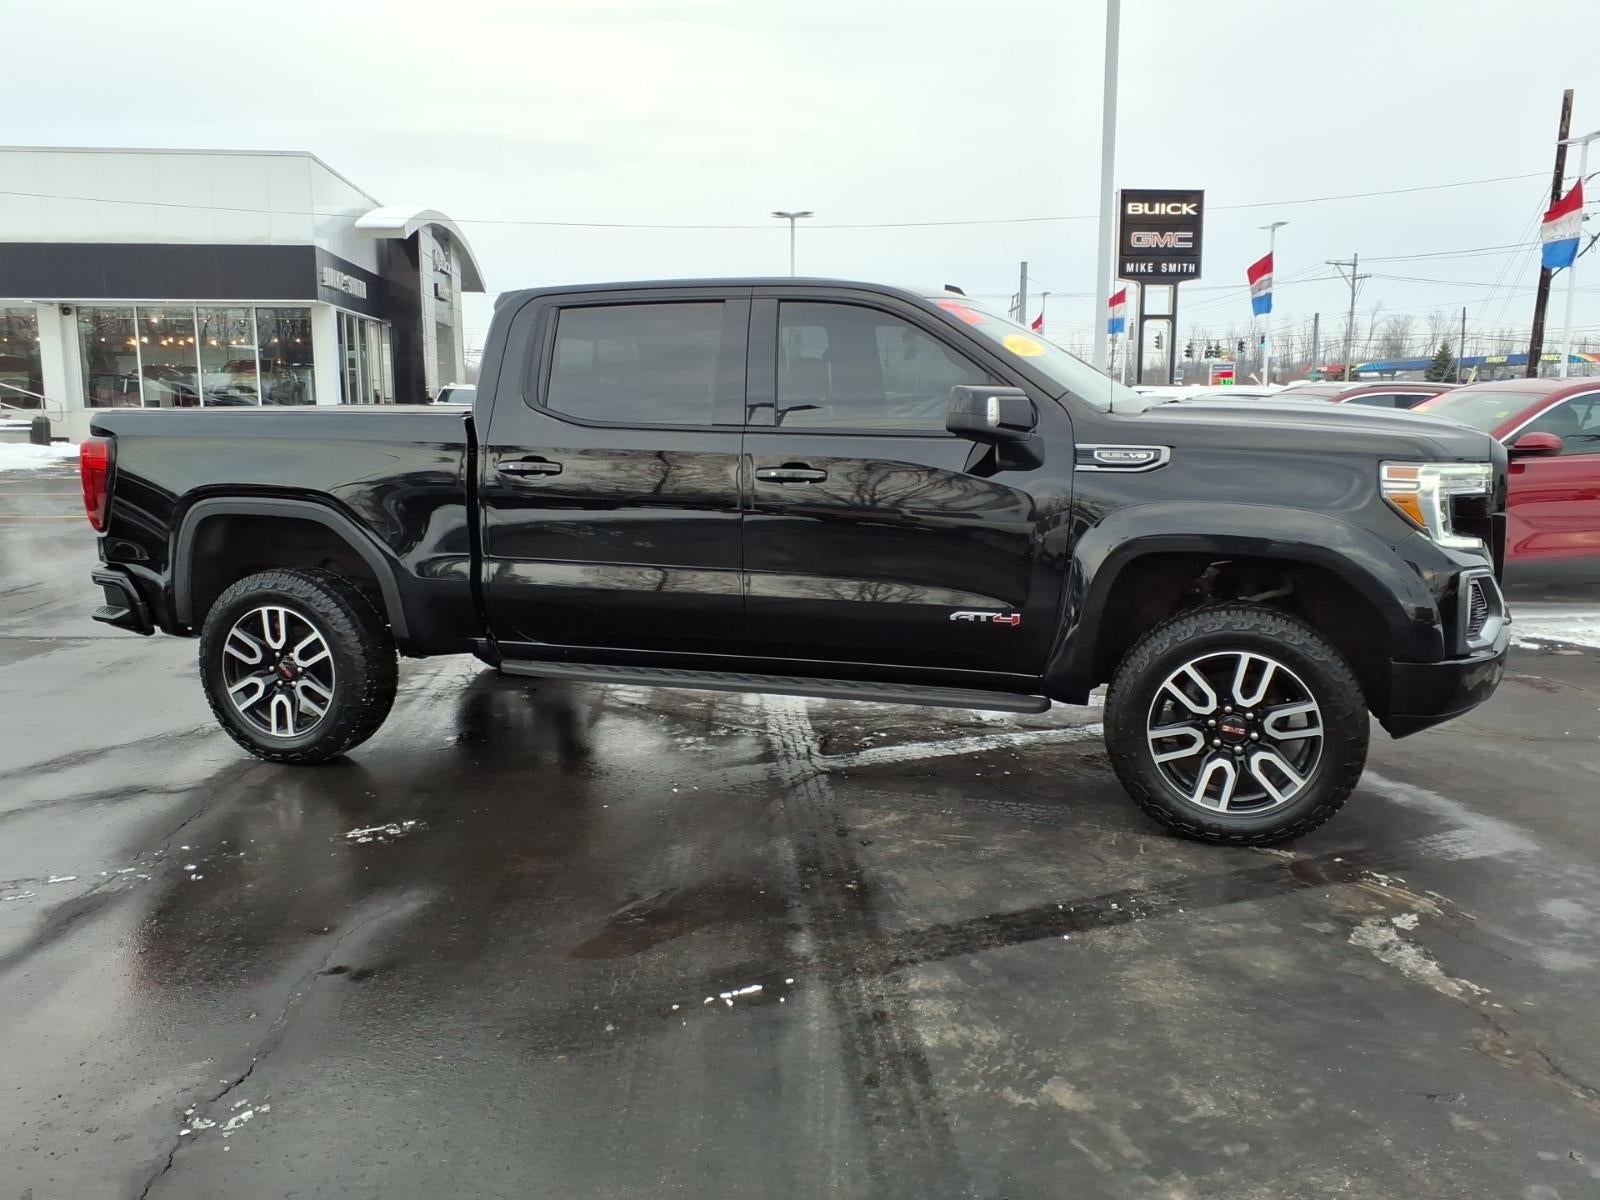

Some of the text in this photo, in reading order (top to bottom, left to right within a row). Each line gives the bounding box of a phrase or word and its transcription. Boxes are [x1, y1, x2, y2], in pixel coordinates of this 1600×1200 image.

[1127, 203, 1198, 215] BUICK
[1130, 231, 1193, 248] GMC
[1126, 263, 1196, 273] MIKE SMITH
[949, 611, 1021, 626] AT4
